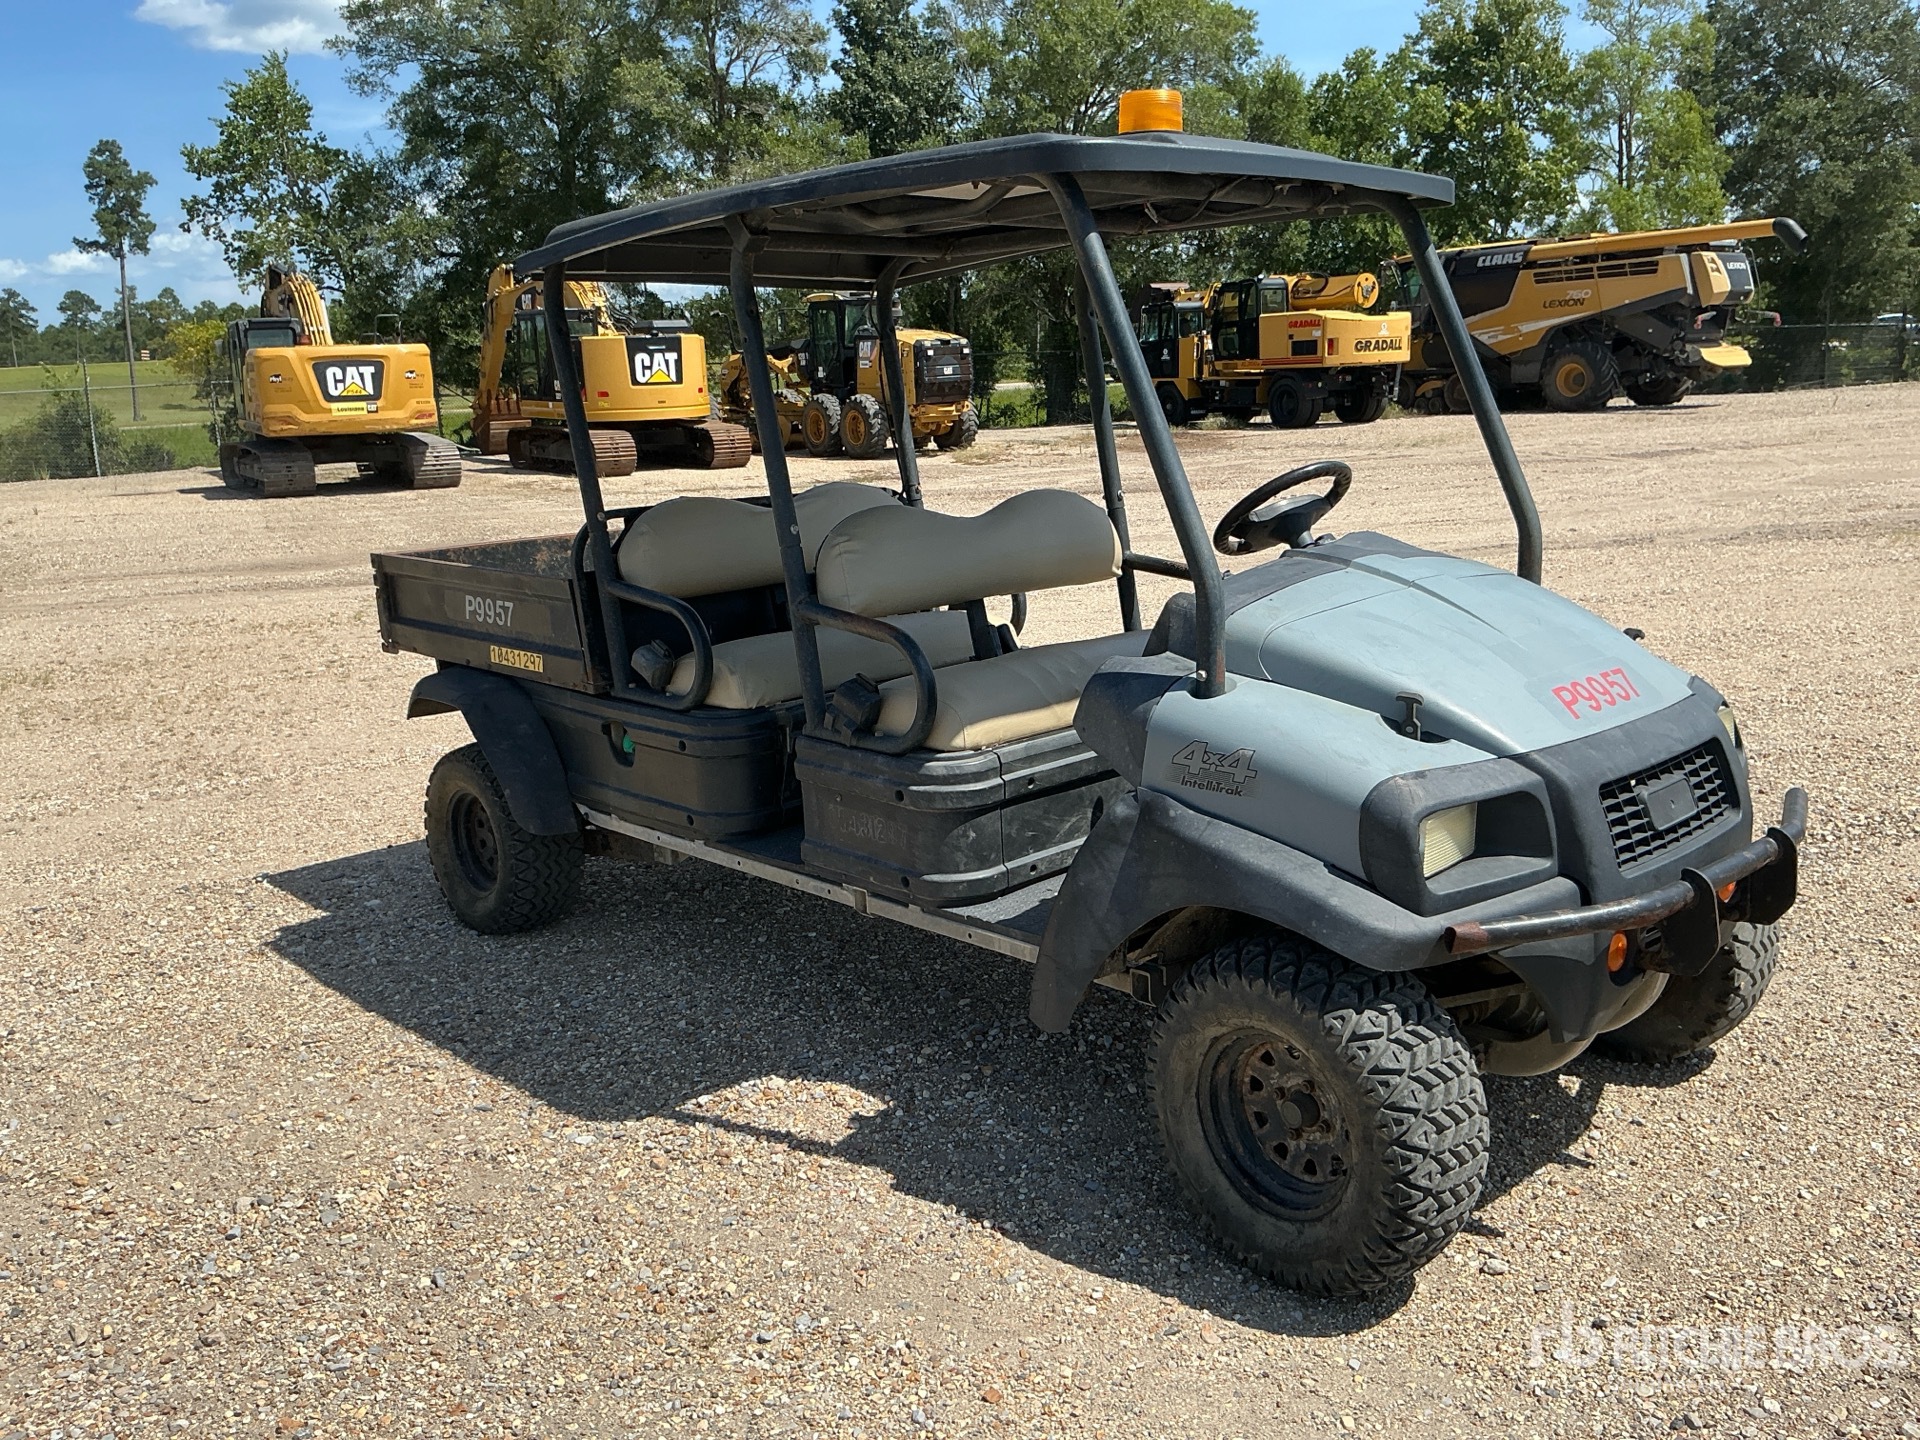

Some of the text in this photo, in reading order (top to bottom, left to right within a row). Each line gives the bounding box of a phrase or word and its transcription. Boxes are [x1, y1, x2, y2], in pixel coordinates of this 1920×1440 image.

[1476, 251, 1524, 268] CLAAS
[1543, 298, 1586, 309] LEXION
[1566, 289, 1592, 300] 760
[1288, 319, 1321, 329] GRADALL
[859, 341, 872, 358] CAT
[1354, 338, 1402, 353] GRADALL
[634, 352, 678, 384] CAT
[325, 365, 375, 397] CAT
[465, 594, 513, 627] P9957
[491, 646, 543, 671] 10431297
[1551, 667, 1640, 720] P9957
[1171, 739, 1258, 785] 4x4
[1180, 775, 1244, 797] IntelliTrak
